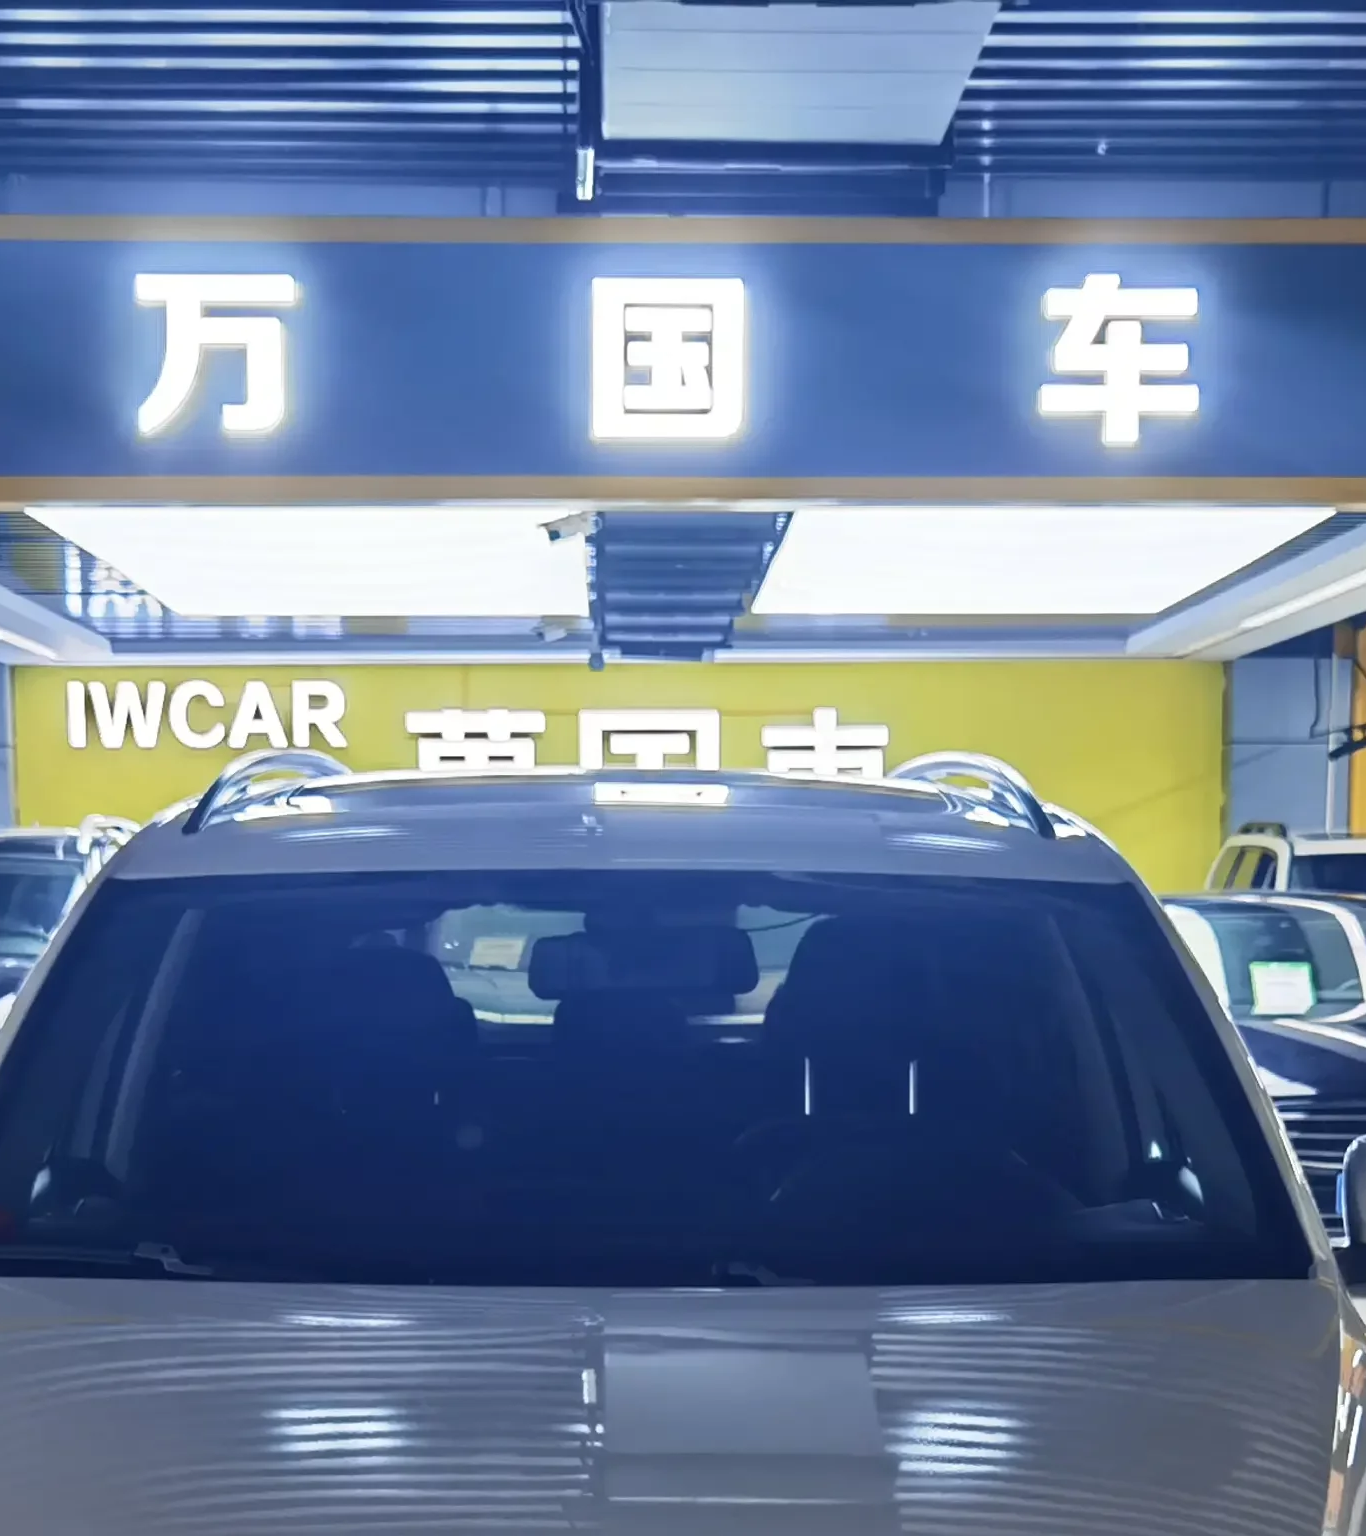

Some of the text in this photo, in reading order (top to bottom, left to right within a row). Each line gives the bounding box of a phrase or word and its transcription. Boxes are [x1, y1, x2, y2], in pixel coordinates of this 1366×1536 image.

[135, 272, 1200, 446] 万国车
[66, 679, 348, 750] IWCAR
